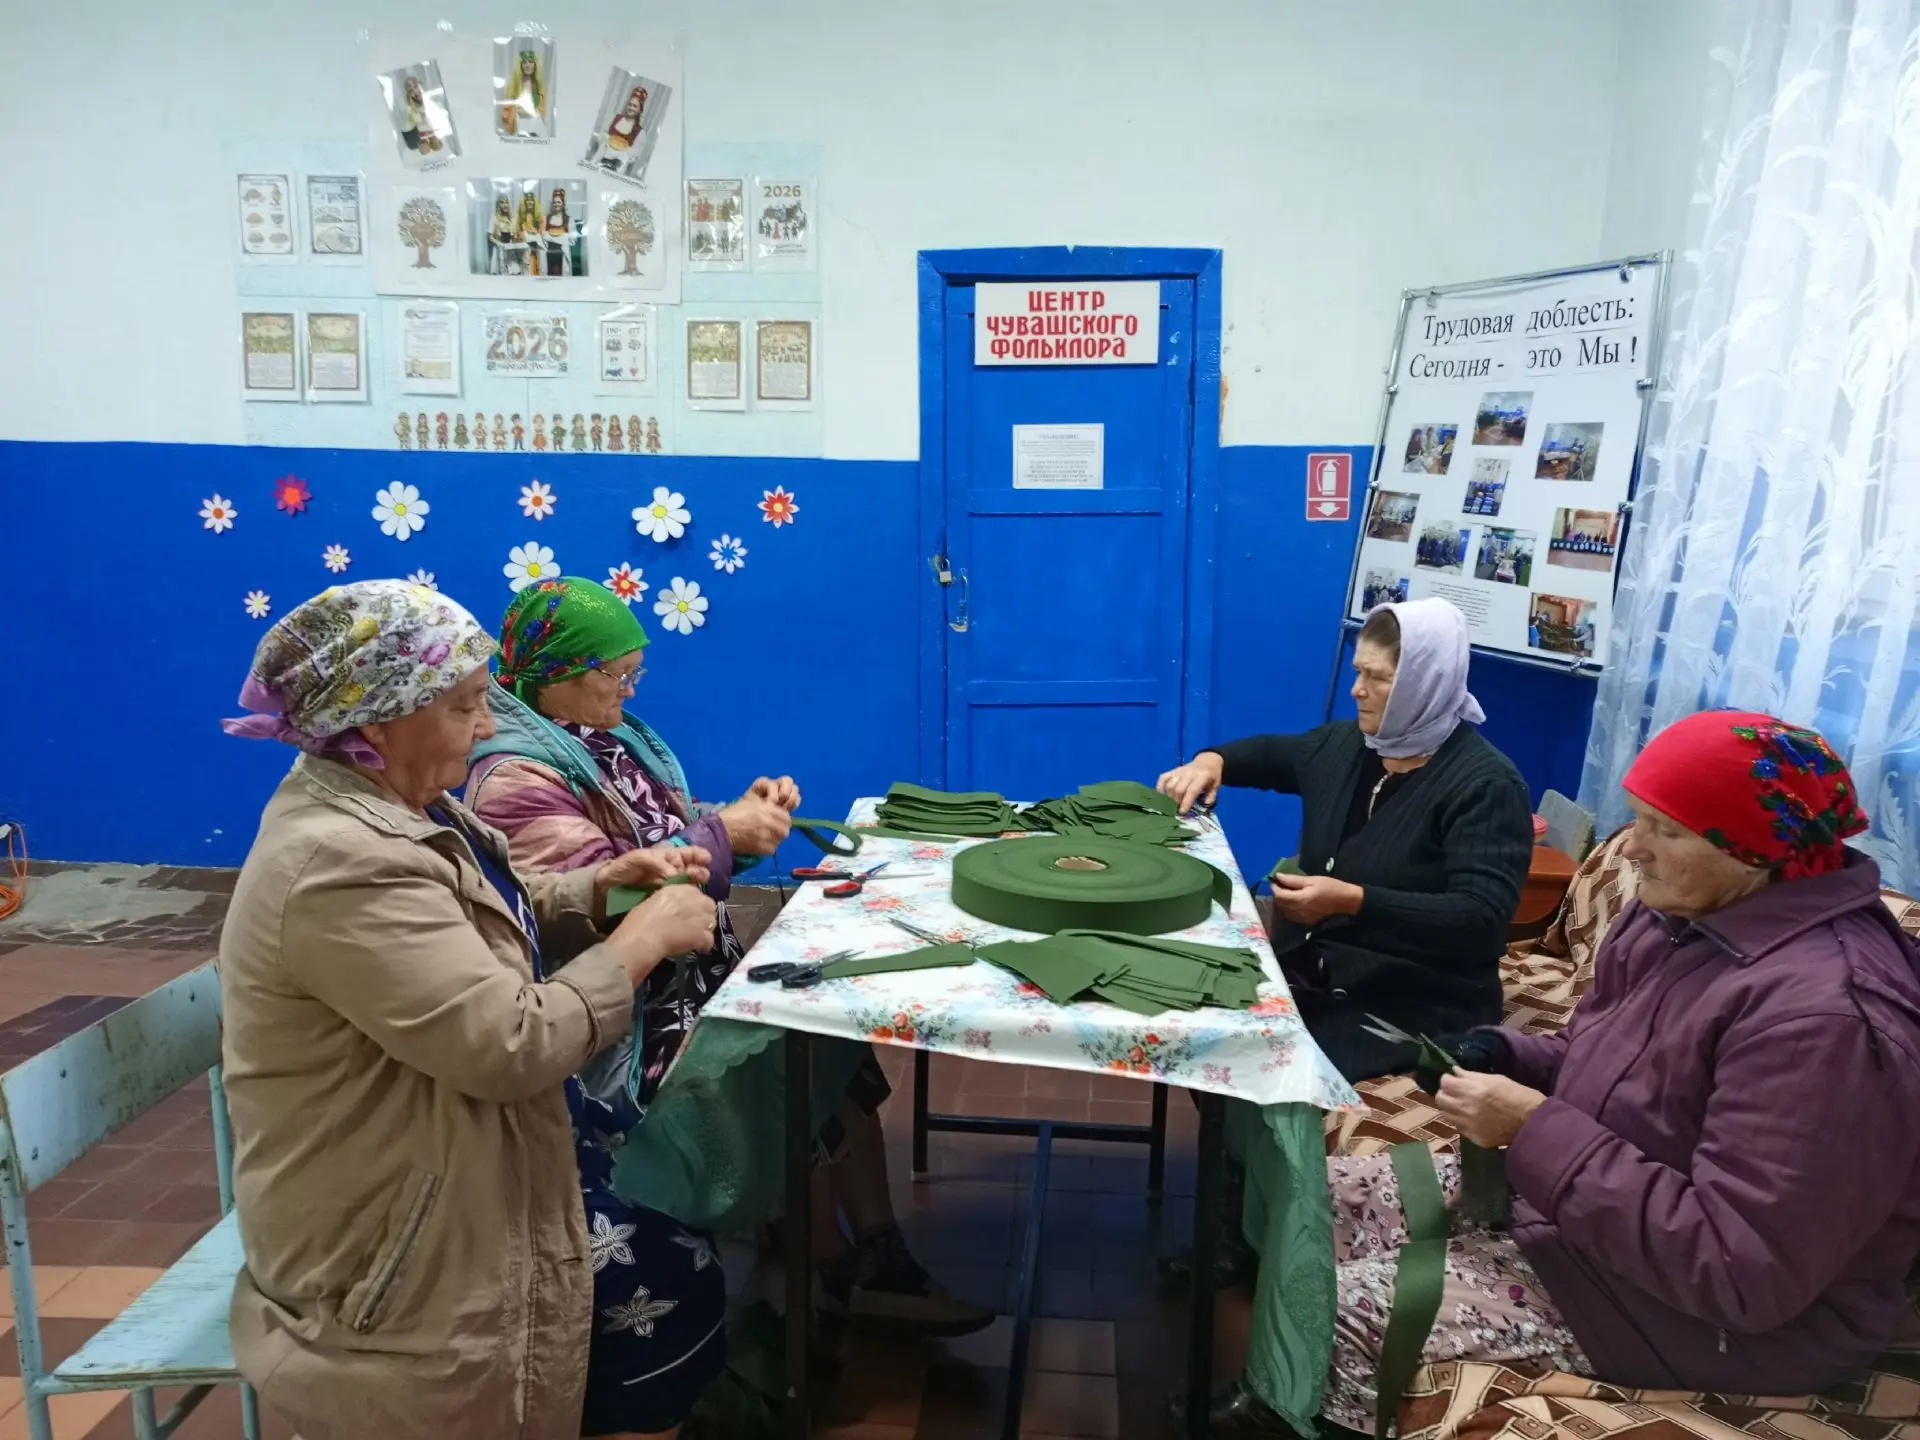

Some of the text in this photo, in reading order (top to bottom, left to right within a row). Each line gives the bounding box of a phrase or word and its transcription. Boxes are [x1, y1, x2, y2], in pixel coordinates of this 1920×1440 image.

[763, 185, 801, 198] 2026
[1028, 290, 1106, 312] ЦЕНТР
[986, 314, 1139, 337] ЧУВАШСКОГО
[1424, 297, 1635, 346] Трудовая доблесть:
[486, 323, 569, 362] 2026
[990, 336, 1127, 359] ФОЛЬКЛОРА
[1526, 348, 1562, 370] это
